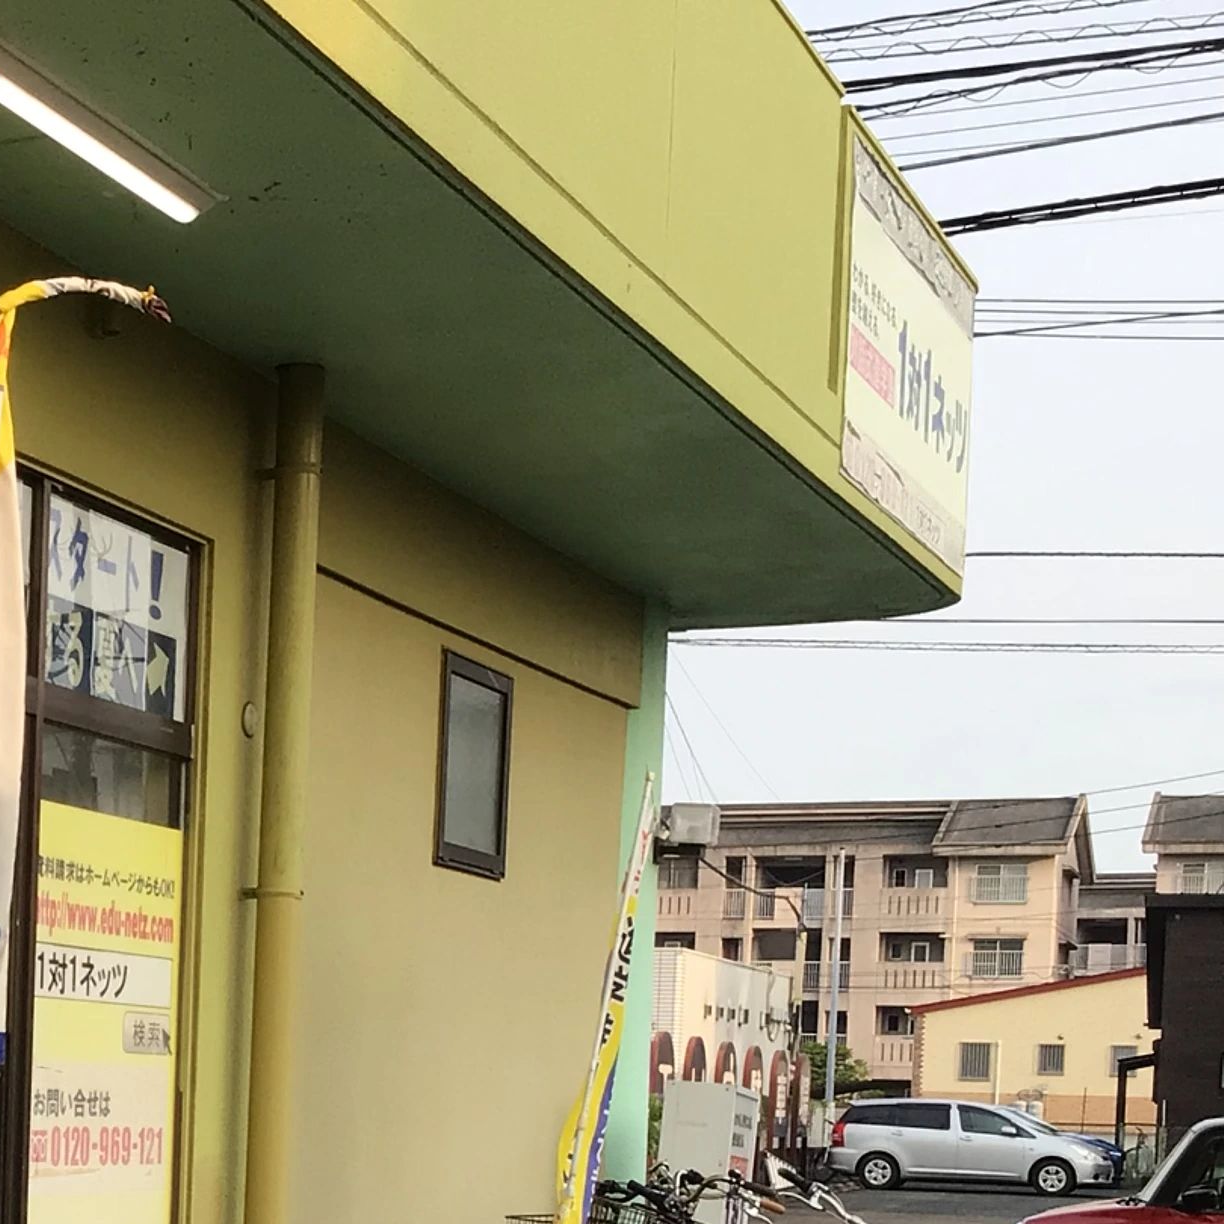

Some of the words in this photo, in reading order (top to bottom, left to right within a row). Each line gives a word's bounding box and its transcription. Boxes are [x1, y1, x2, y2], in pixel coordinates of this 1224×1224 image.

[898, 319, 968, 474] 1対1ネッツ
[38, 950, 128, 998] 1対1ネッツ
[132, 1019, 161, 1048] 検索
[33, 1088, 111, 1118] お問い合せは
[51, 1125, 163, 1167] 0120-969-121
